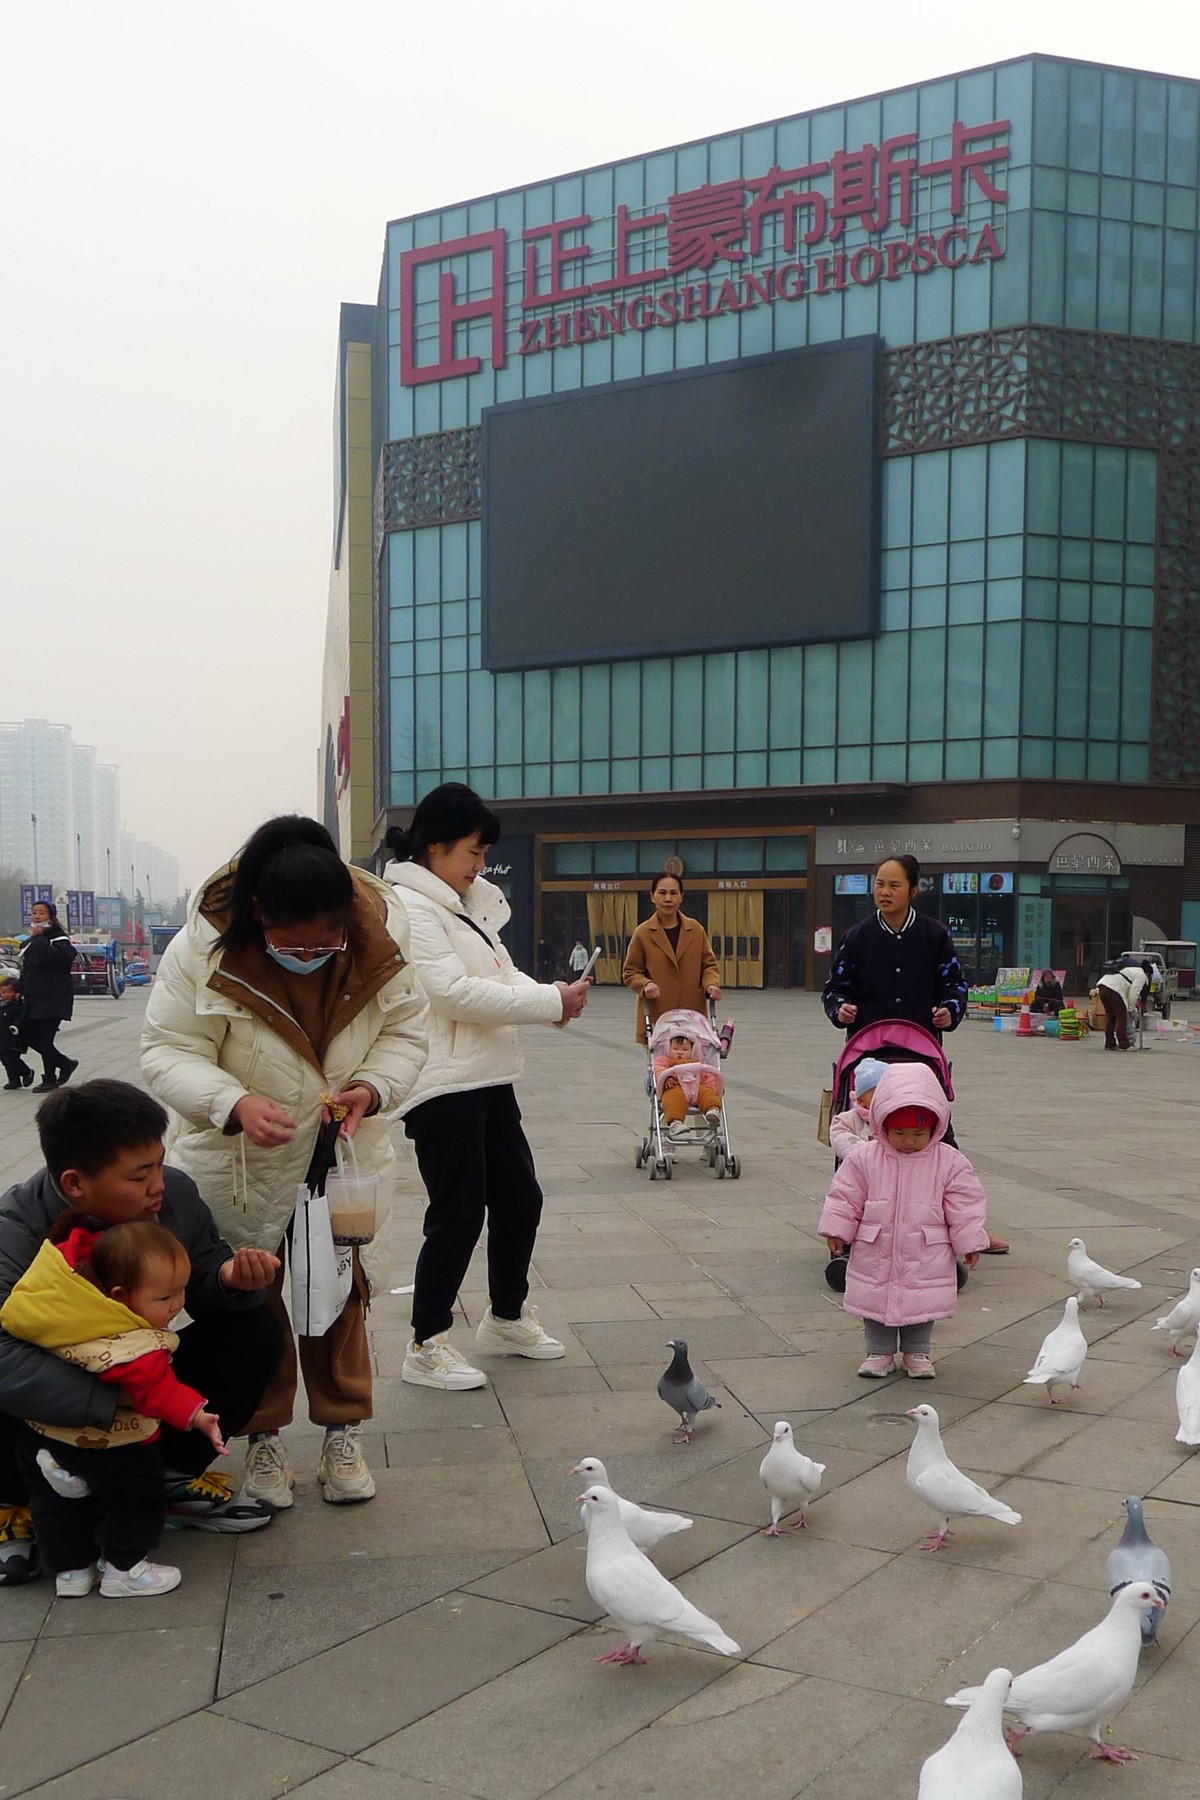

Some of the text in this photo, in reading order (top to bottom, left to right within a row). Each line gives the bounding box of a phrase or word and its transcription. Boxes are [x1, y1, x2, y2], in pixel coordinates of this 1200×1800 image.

[521, 119, 1010, 309] 正上豪布斯卡
[518, 222, 1006, 355] ZHENGSHANG HOPSCA
[493, 863, 513, 876] Hut
[114, 1417, 140, 1432] D&G
